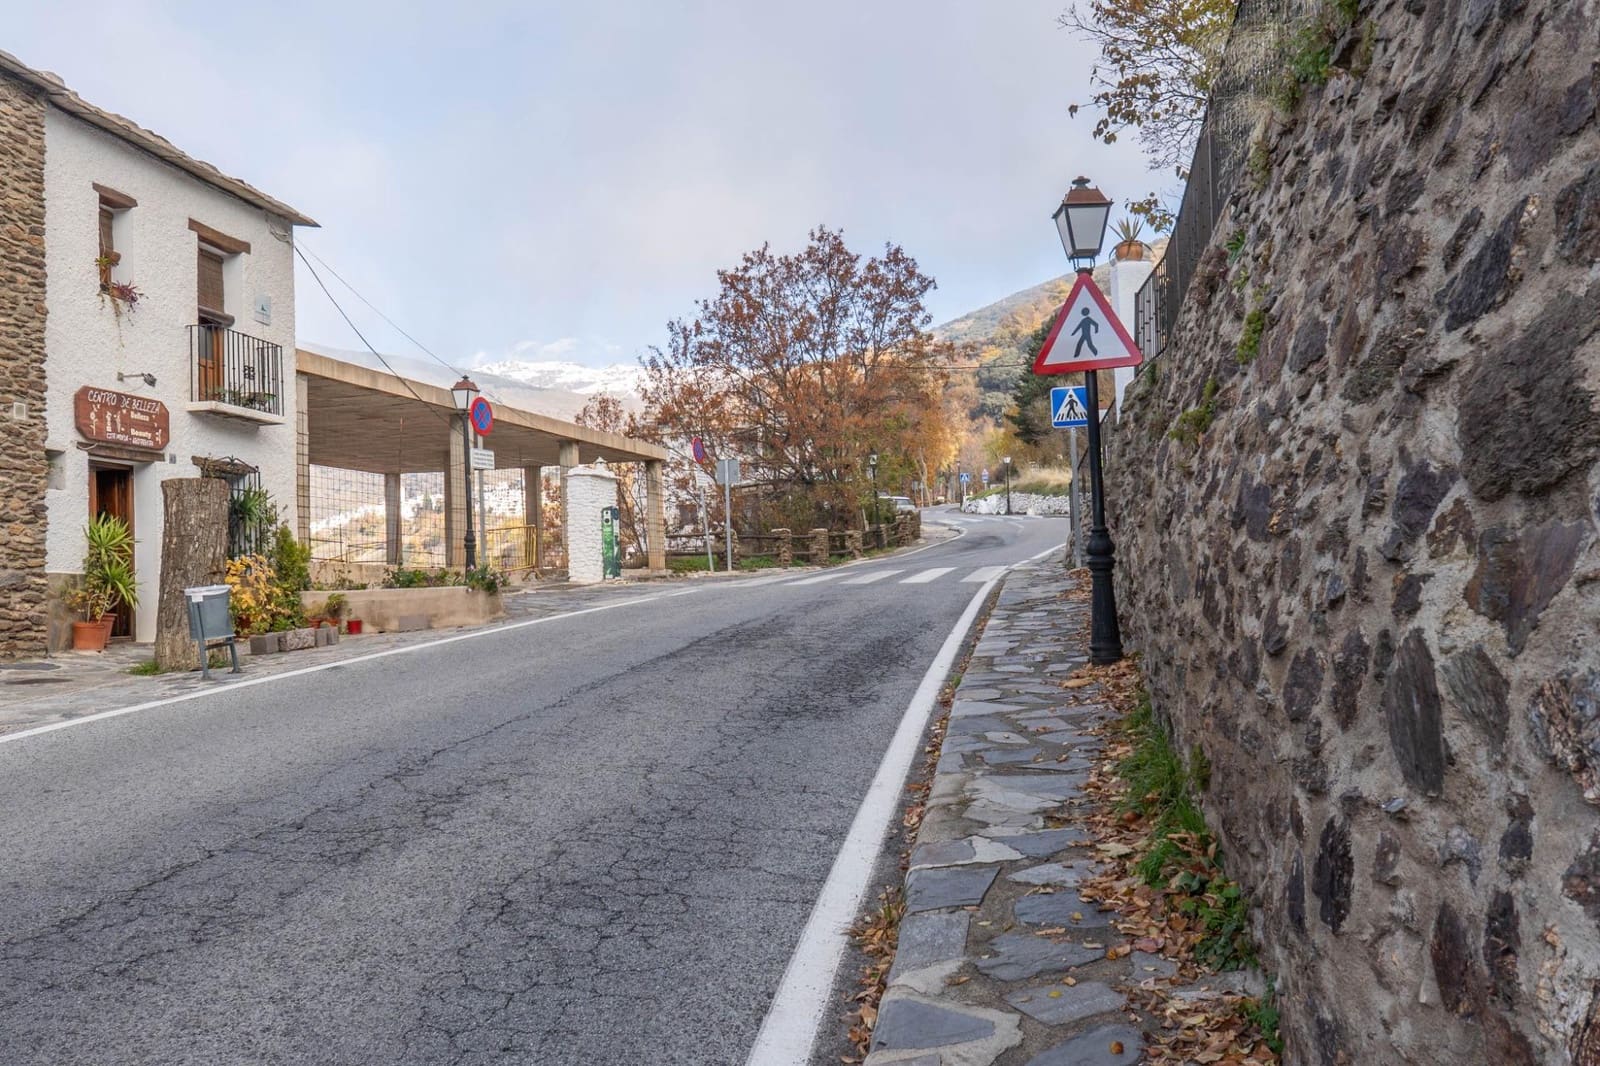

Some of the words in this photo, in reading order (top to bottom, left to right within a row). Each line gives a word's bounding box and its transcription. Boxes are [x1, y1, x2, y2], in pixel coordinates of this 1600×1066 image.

[88, 390, 117, 406] CENTRO
[121, 396, 131, 408] DE
[132, 399, 160, 415] BELLEZA
